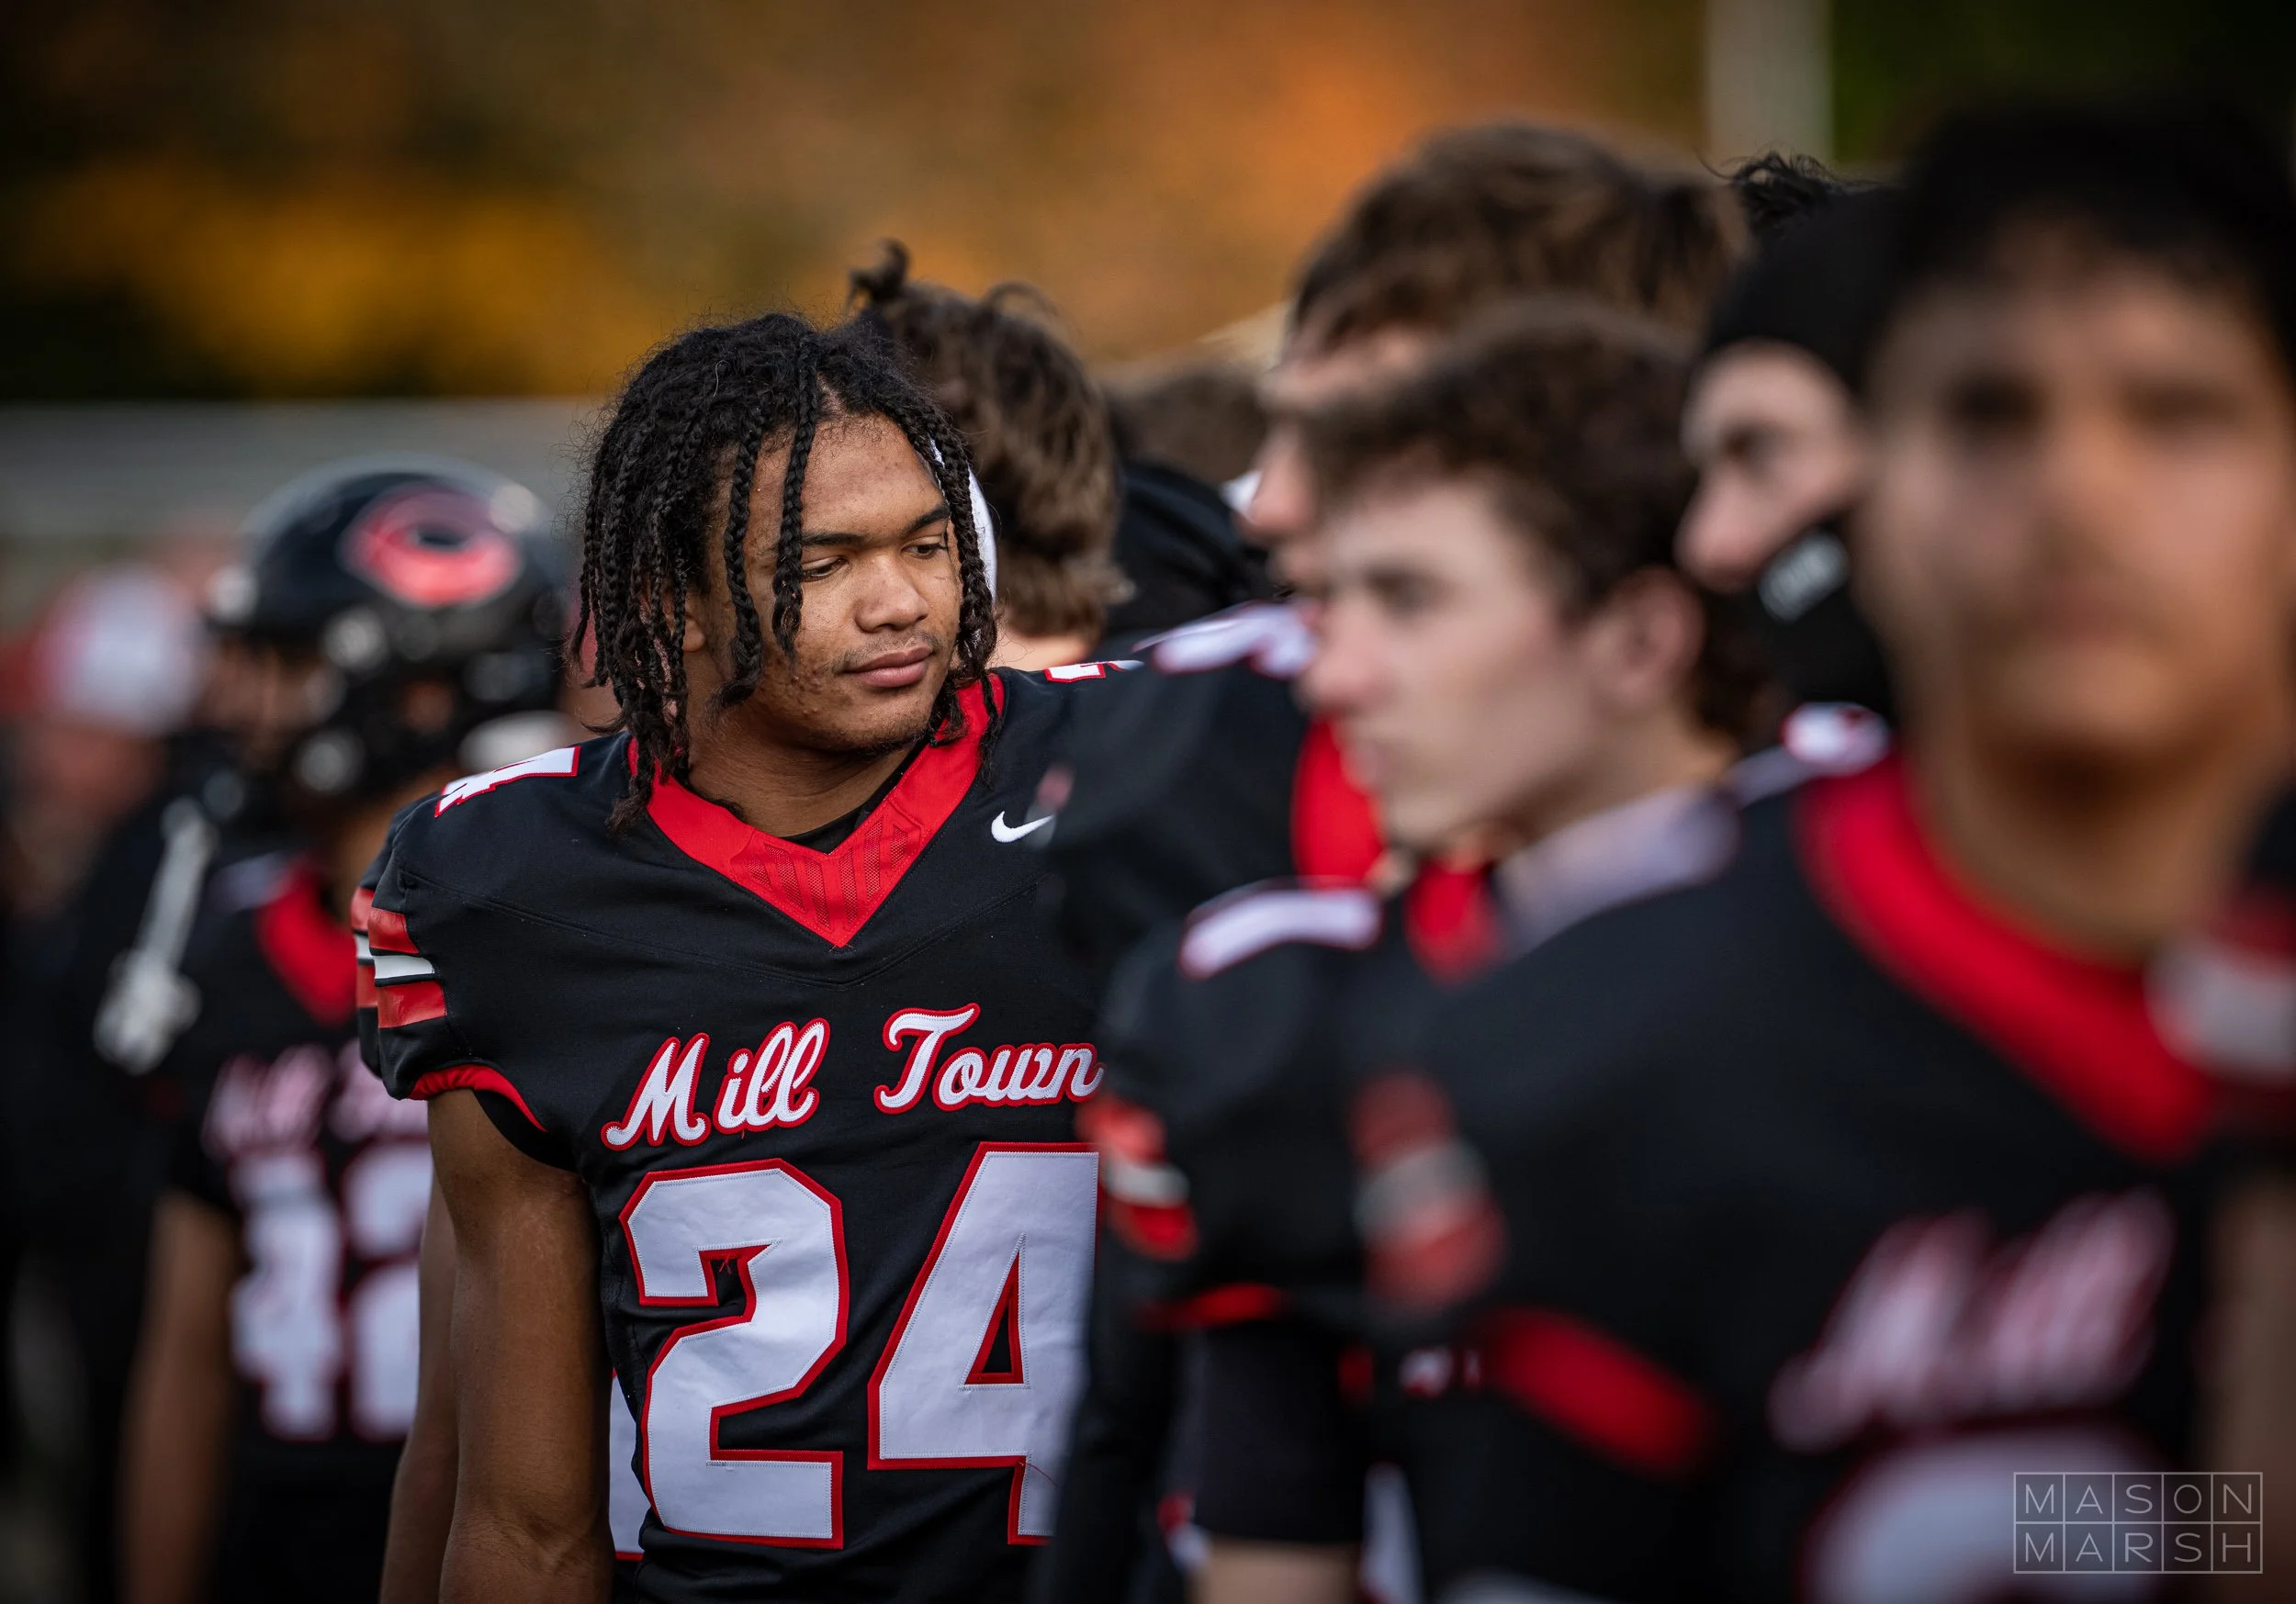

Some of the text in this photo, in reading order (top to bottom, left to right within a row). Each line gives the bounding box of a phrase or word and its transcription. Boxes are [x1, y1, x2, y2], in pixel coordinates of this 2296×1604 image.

[601, 1003, 1104, 1151] Mill Town
[618, 1140, 1101, 1550] 24
